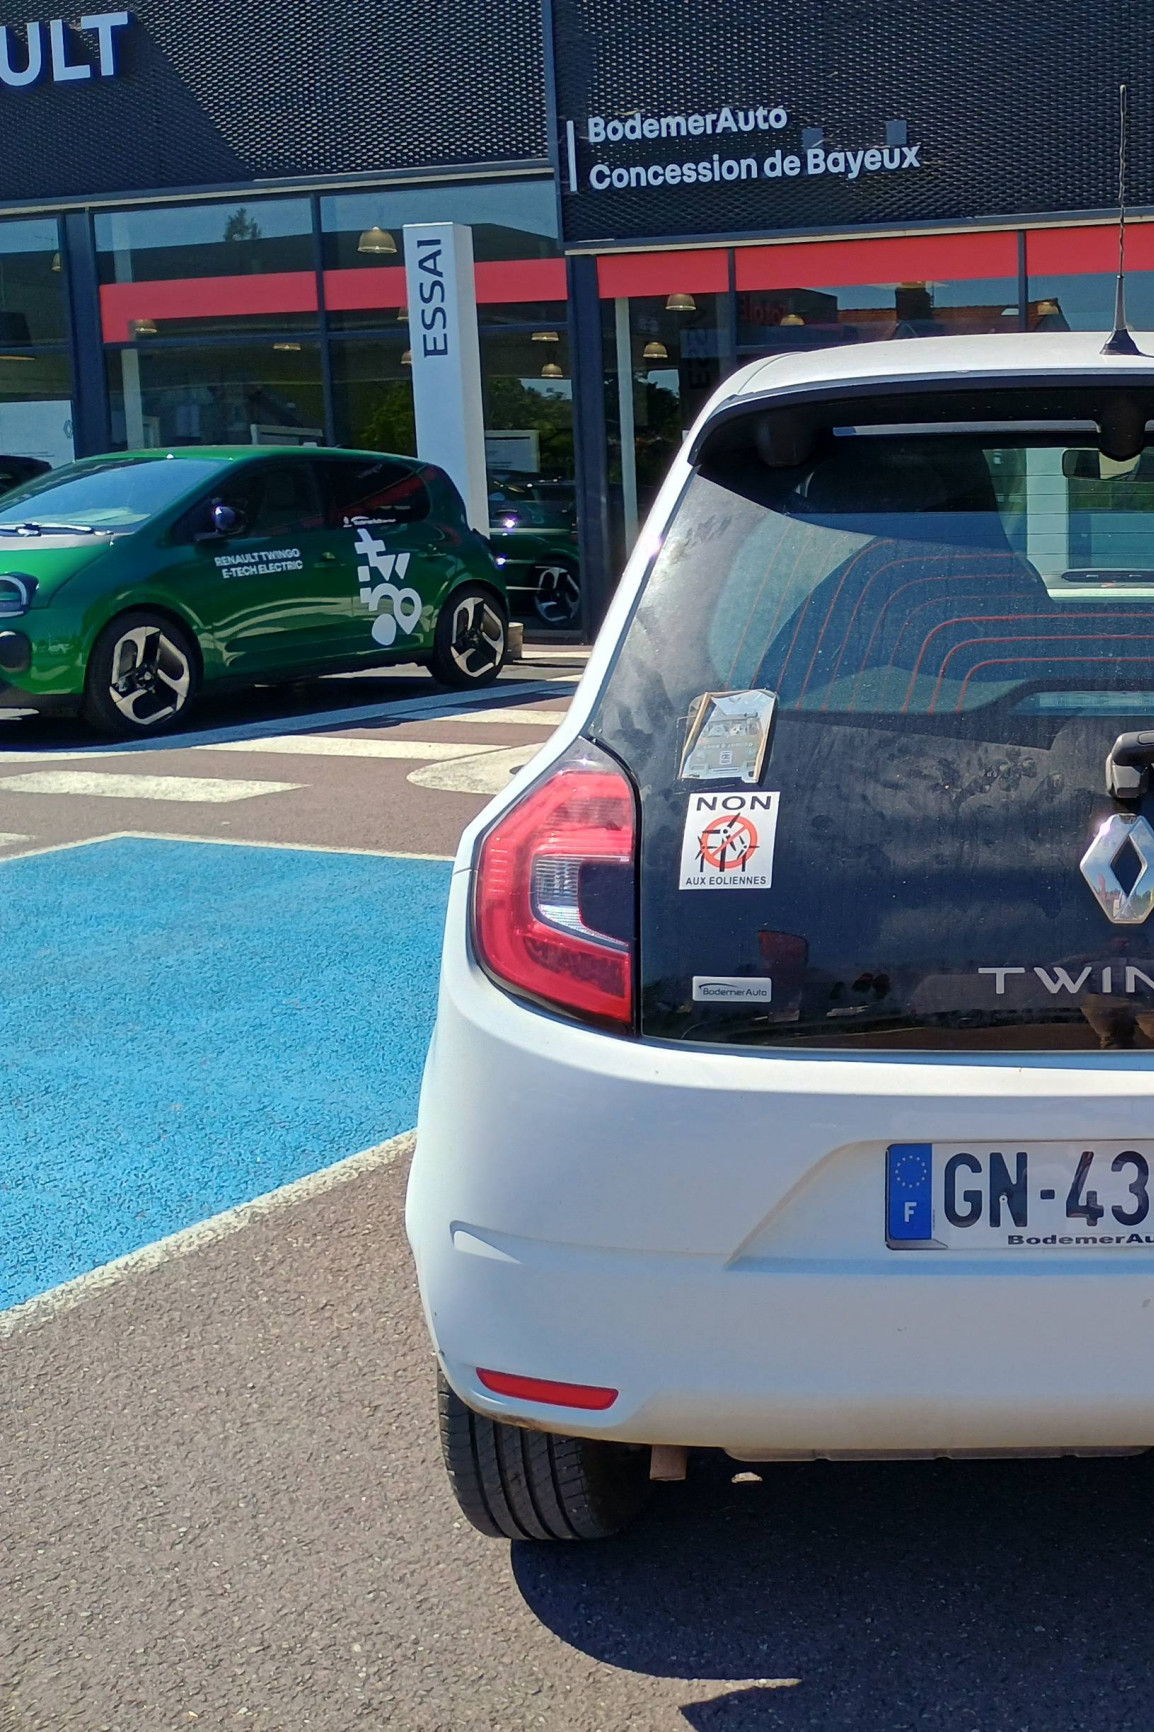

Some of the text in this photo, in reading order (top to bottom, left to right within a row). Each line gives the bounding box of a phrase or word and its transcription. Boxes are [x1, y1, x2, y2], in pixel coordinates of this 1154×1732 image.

[588, 107, 787, 143] BodemerAuto
[589, 145, 921, 190] Concession de Bayeux
[417, 239, 448, 358] ESSAI
[214, 548, 301, 567] RENAULT TWINGO
[222, 560, 304, 579] E-TECH ELECTRIC
[696, 796, 772, 812] NON
[685, 876, 767, 886] AUX EOLIENNES
[702, 987, 768, 997] BodemerAuto
[904, 1201, 918, 1223] F
